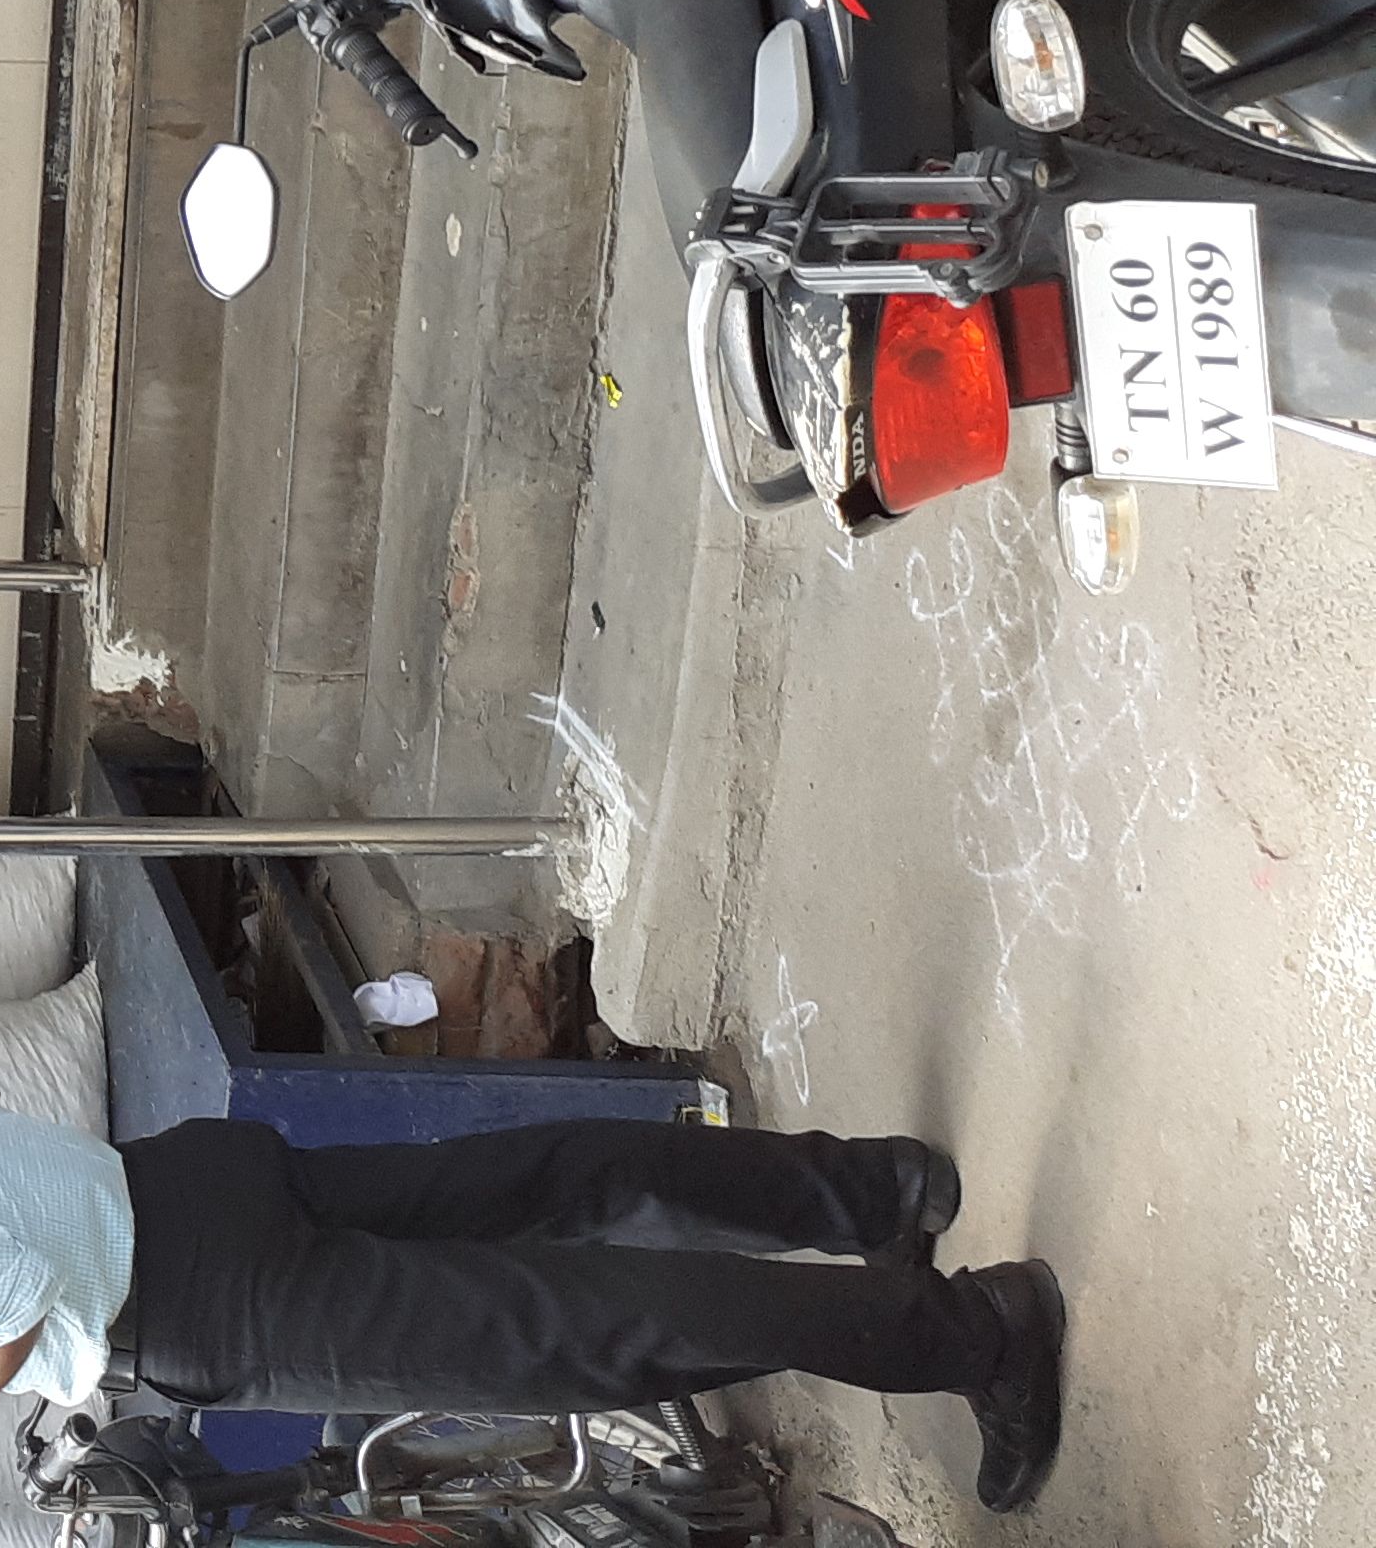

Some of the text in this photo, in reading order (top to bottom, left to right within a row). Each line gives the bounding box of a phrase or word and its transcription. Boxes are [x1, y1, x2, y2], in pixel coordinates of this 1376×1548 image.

[1109, 258, 1171, 433] TN 60
[1184, 241, 1246, 457] W 1989
